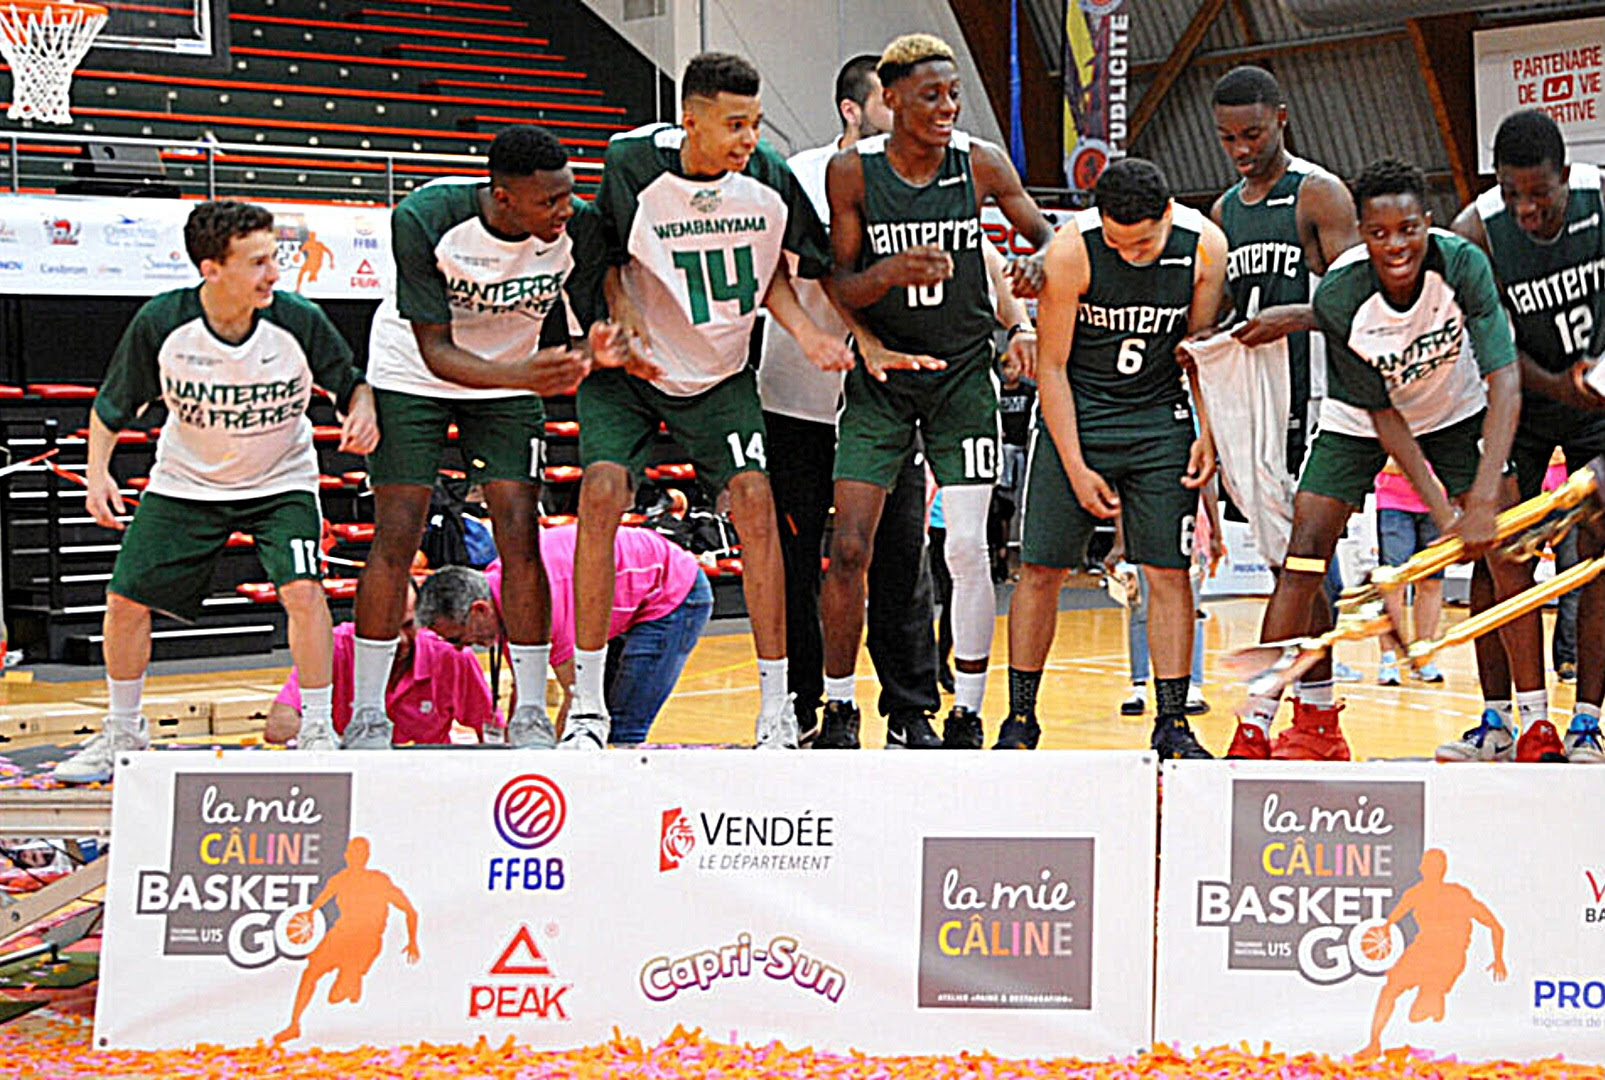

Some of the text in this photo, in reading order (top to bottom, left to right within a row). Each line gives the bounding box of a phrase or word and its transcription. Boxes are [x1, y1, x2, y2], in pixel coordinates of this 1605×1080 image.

[1512, 45, 1602, 80] PARTENAIRE
[1518, 71, 1601, 105] DE LA VIE
[653, 216, 767, 240] WEMBANYAMA
[671, 245, 760, 326] 14
[1554, 303, 1594, 355] 12
[1116, 338, 1147, 375] 6
[209, 398, 305, 429] FRÈRES
[727, 431, 767, 470] 14
[962, 437, 995, 478] 10
[202, 785, 322, 824] la mie
[1262, 793, 1393, 835] la mie
[199, 826, 321, 866] CÂLINE
[700, 809, 834, 846] VENDÉE
[488, 857, 565, 891] FFBB
[698, 853, 832, 870] LE DÉPARTEMENT
[1262, 836, 1393, 877] CÂLINE
[138, 873, 320, 912] BASKET
[942, 868, 1076, 912] la mie
[1199, 885, 1393, 925] BASKET
[201, 928, 223, 943] U15
[227, 904, 327, 968] GO
[937, 913, 1073, 957] CÂLINE
[1268, 942, 1292, 957] U15
[1298, 918, 1405, 985] GO
[640, 931, 846, 1003] Capri-Sun
[468, 984, 573, 1019] PEAK
